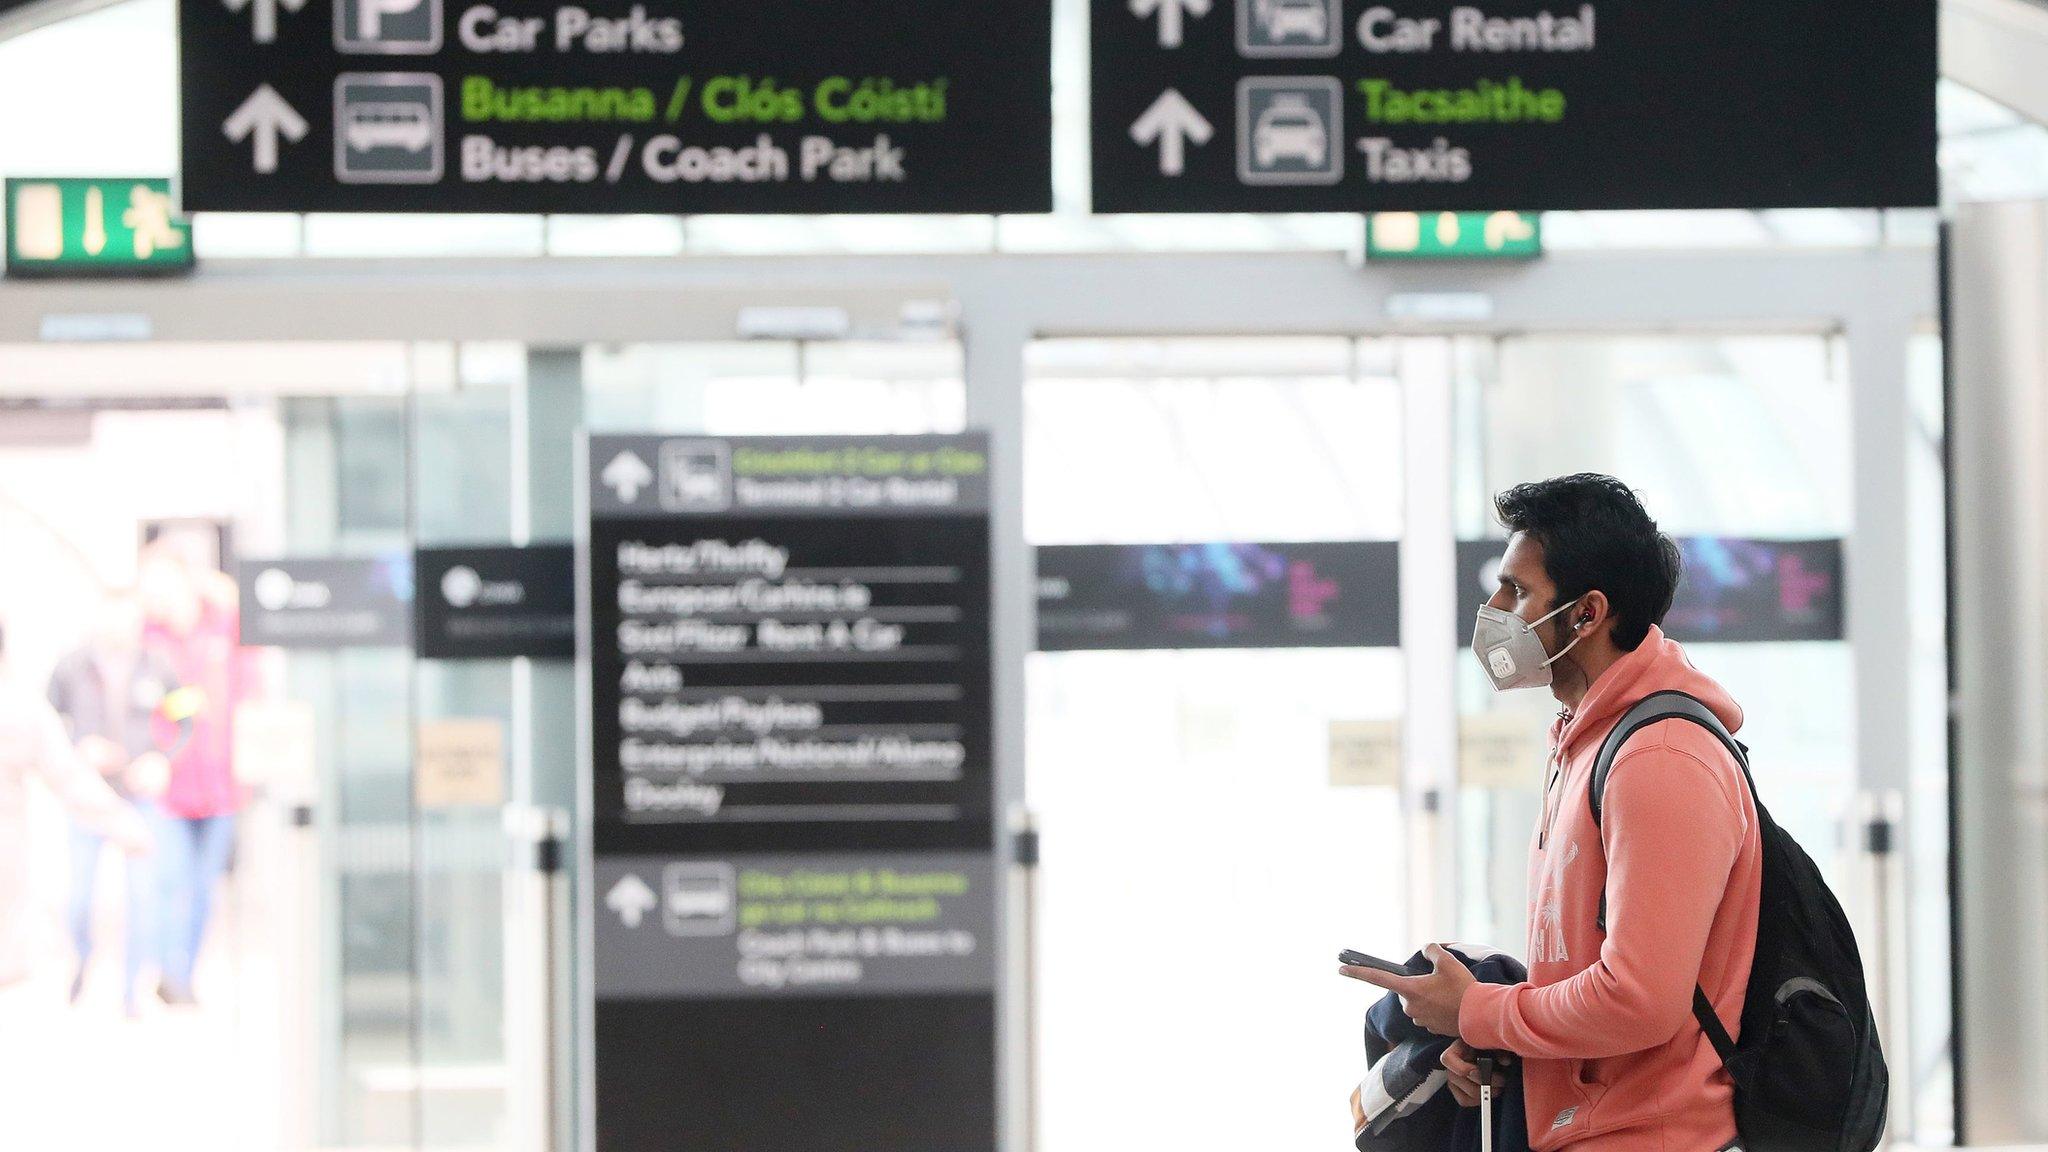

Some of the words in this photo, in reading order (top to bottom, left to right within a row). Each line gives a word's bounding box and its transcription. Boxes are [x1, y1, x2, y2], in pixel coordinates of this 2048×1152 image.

[458, 5, 543, 52] Car
[555, 4, 684, 52] Parks
[1357, 6, 1443, 53] Car
[1450, 4, 1597, 53] Rental
[460, 75, 656, 123] Busanna
[665, 74, 694, 124] /
[700, 76, 803, 122] Clós
[814, 74, 949, 122] Cóistí
[1358, 78, 1567, 122] Tacsaithe
[461, 135, 597, 182] Buses
[605, 134, 634, 183] /
[641, 135, 788, 183] Coach
[801, 134, 907, 182] Park
[1358, 137, 1474, 183] Taxis
